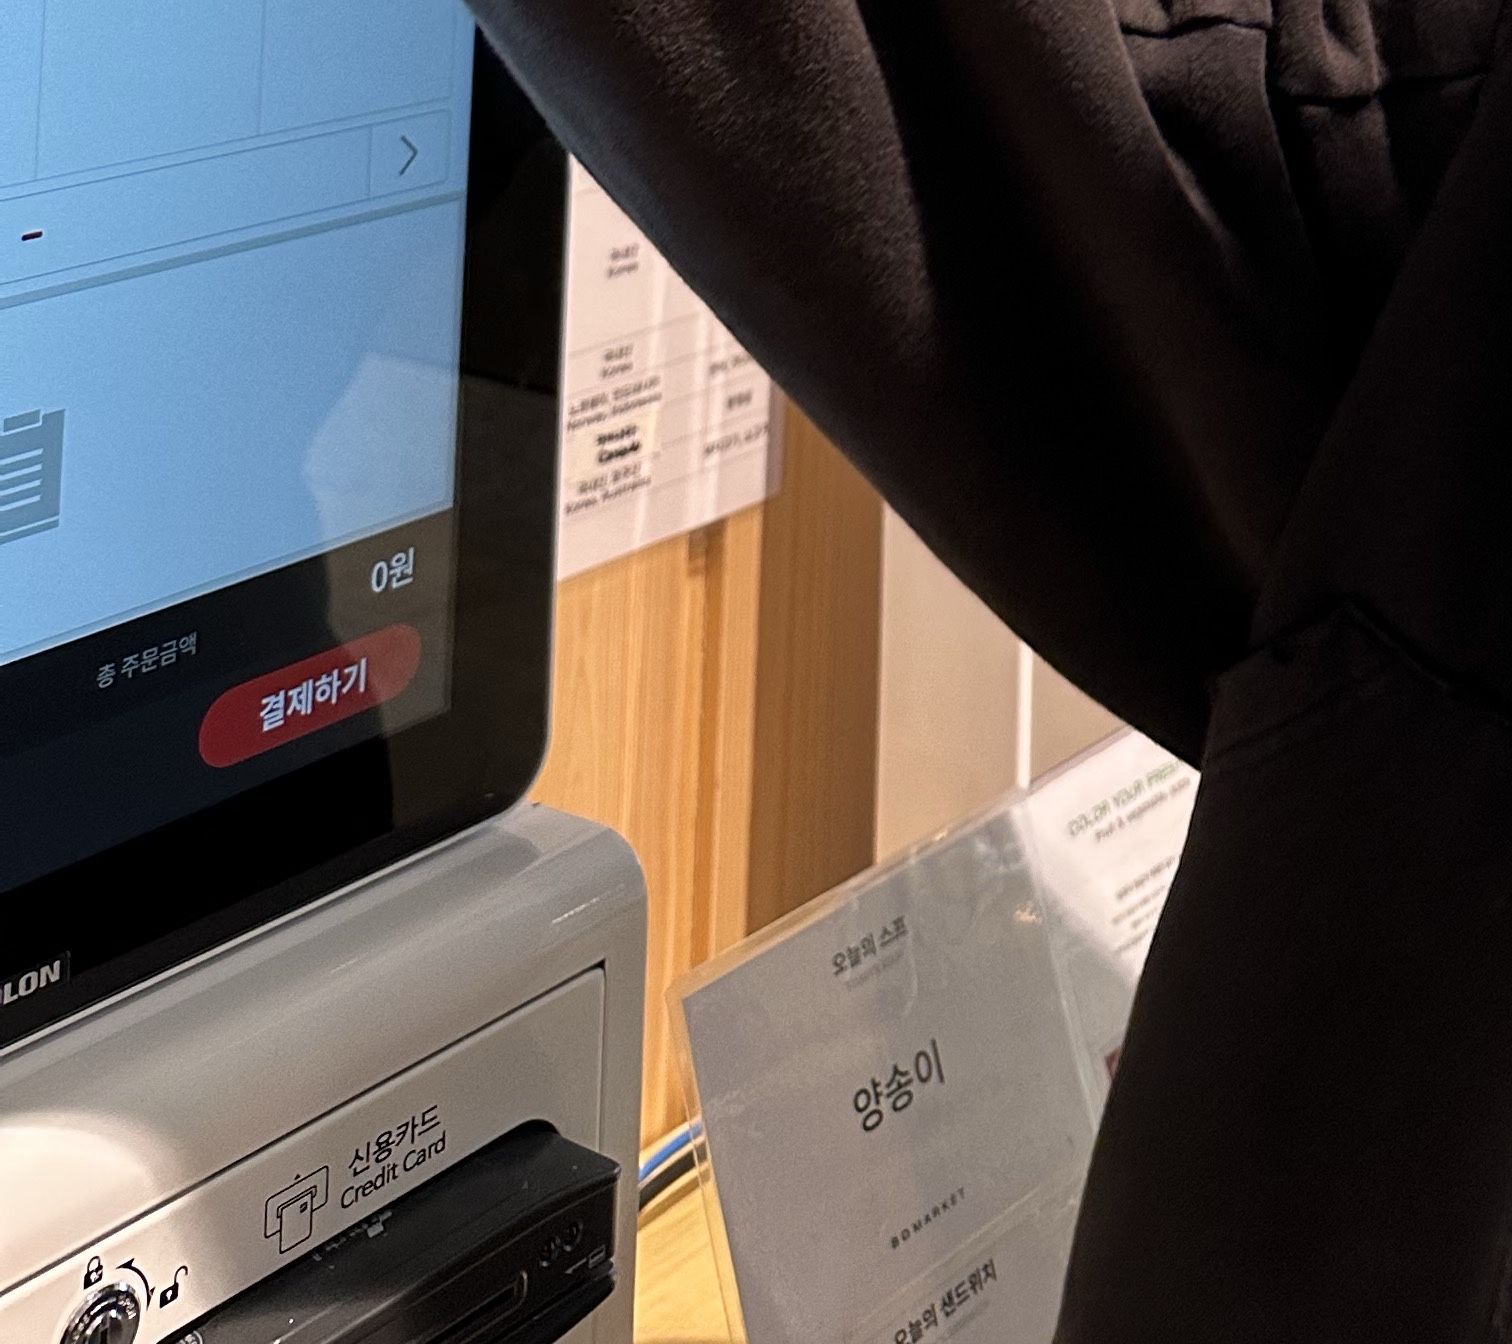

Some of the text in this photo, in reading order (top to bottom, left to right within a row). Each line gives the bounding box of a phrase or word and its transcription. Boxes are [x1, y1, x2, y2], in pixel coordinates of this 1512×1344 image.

[371, 547, 415, 593] 0원
[96, 631, 197, 688] 총 주문금액
[260, 657, 368, 732] 결제하기
[0, 959, 60, 1005] LON
[832, 931, 877, 976] 오늘의
[853, 1037, 945, 1132] 양송이
[341, 1130, 446, 1208] Credit Card
[348, 1105, 441, 1177] 신용카드
[940, 1258, 998, 1318] 샌드위치
